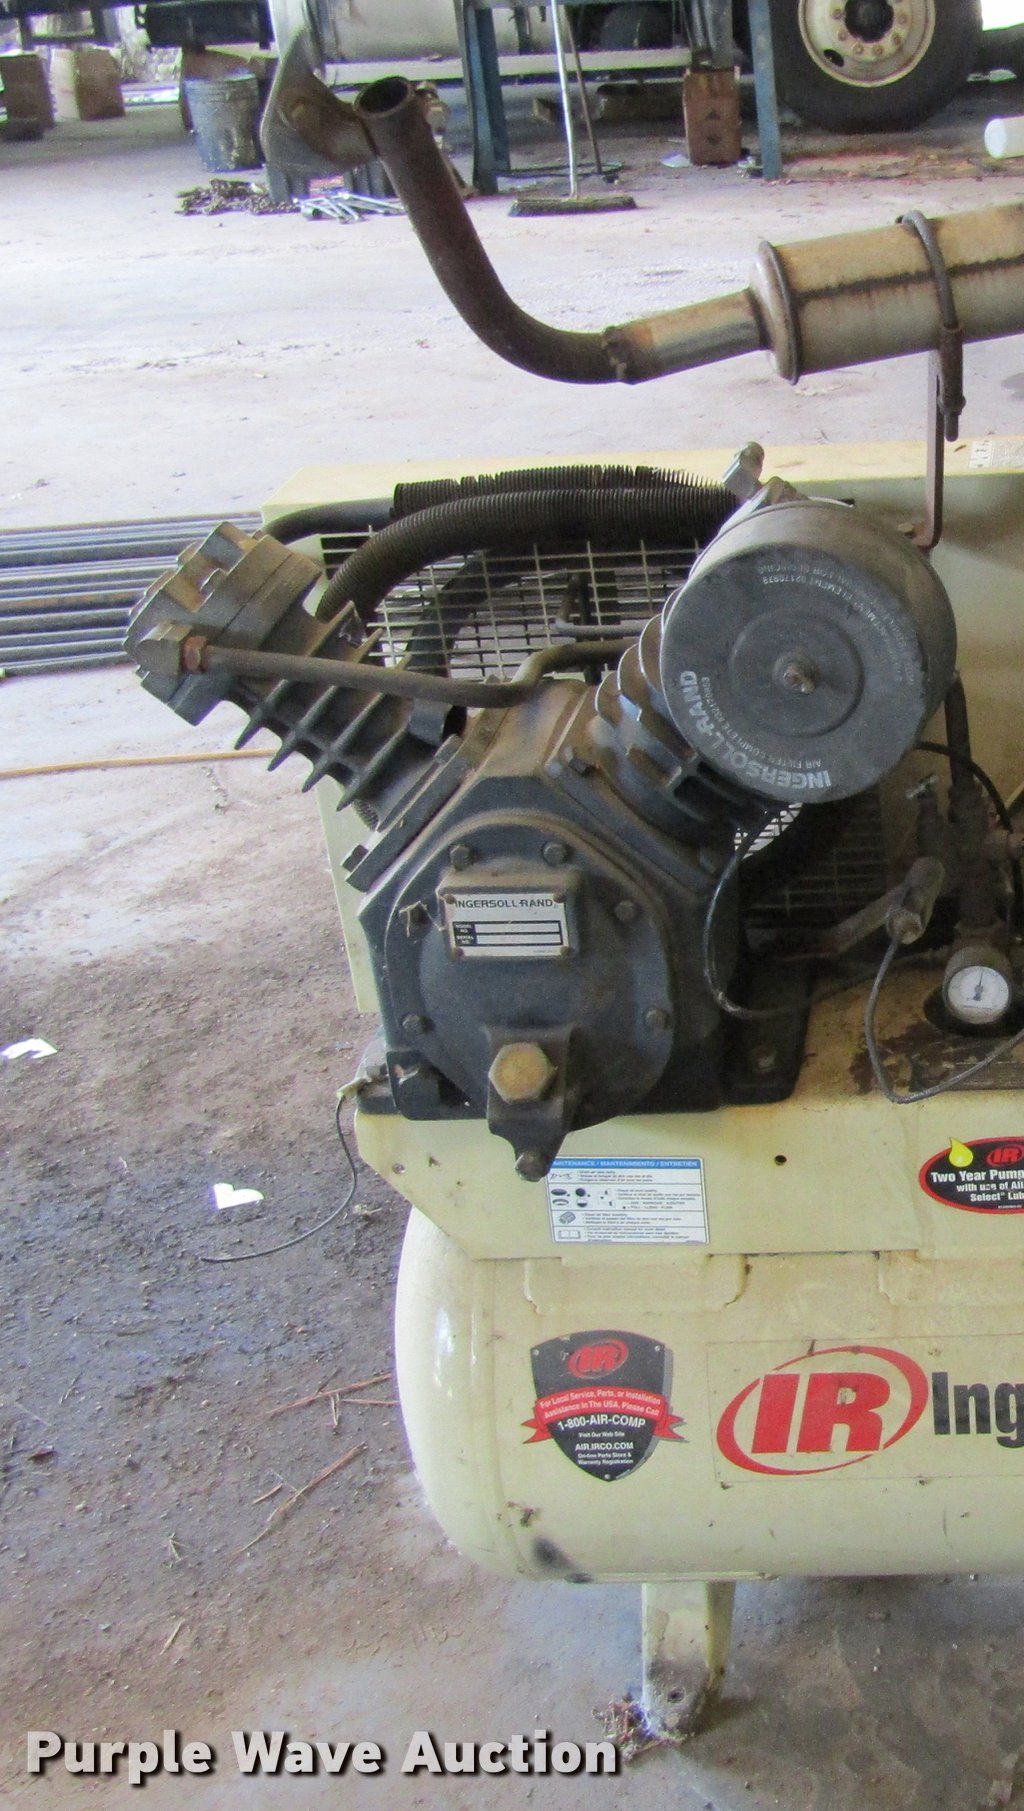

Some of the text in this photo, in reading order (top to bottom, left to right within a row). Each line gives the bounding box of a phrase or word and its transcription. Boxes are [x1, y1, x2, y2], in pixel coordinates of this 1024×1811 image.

[931, 1172, 956, 1183] Two
[959, 1170, 986, 1181] Year
[990, 1169, 1024, 1181] Pump
[956, 1183, 977, 1192] with
[999, 1182, 1010, 1190] of
[1011, 1181, 1024, 1190] All
[558, 1414, 646, 1431] 1-800-AIR-COMP
